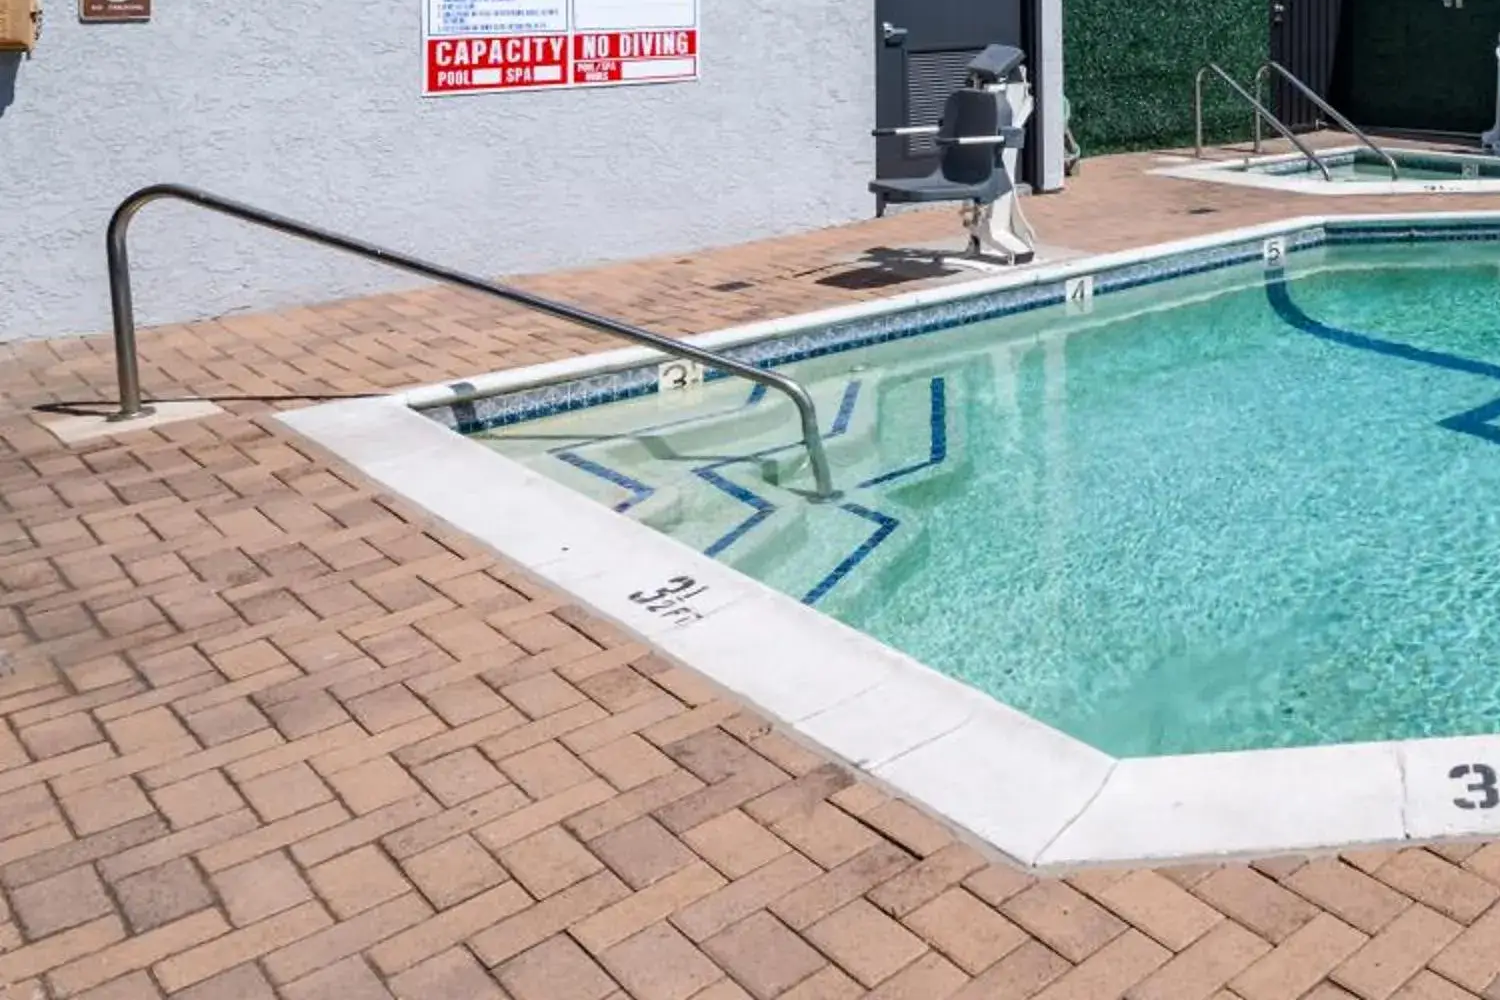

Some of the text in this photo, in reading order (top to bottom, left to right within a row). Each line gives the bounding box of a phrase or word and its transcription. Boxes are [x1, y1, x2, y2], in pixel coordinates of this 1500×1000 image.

[435, 37, 565, 66] CAPACITY
[582, 32, 689, 59] NO DIVING
[437, 67, 532, 87] POOL SPA
[628, 575, 695, 604] 3
[1448, 763, 1500, 809] 3
